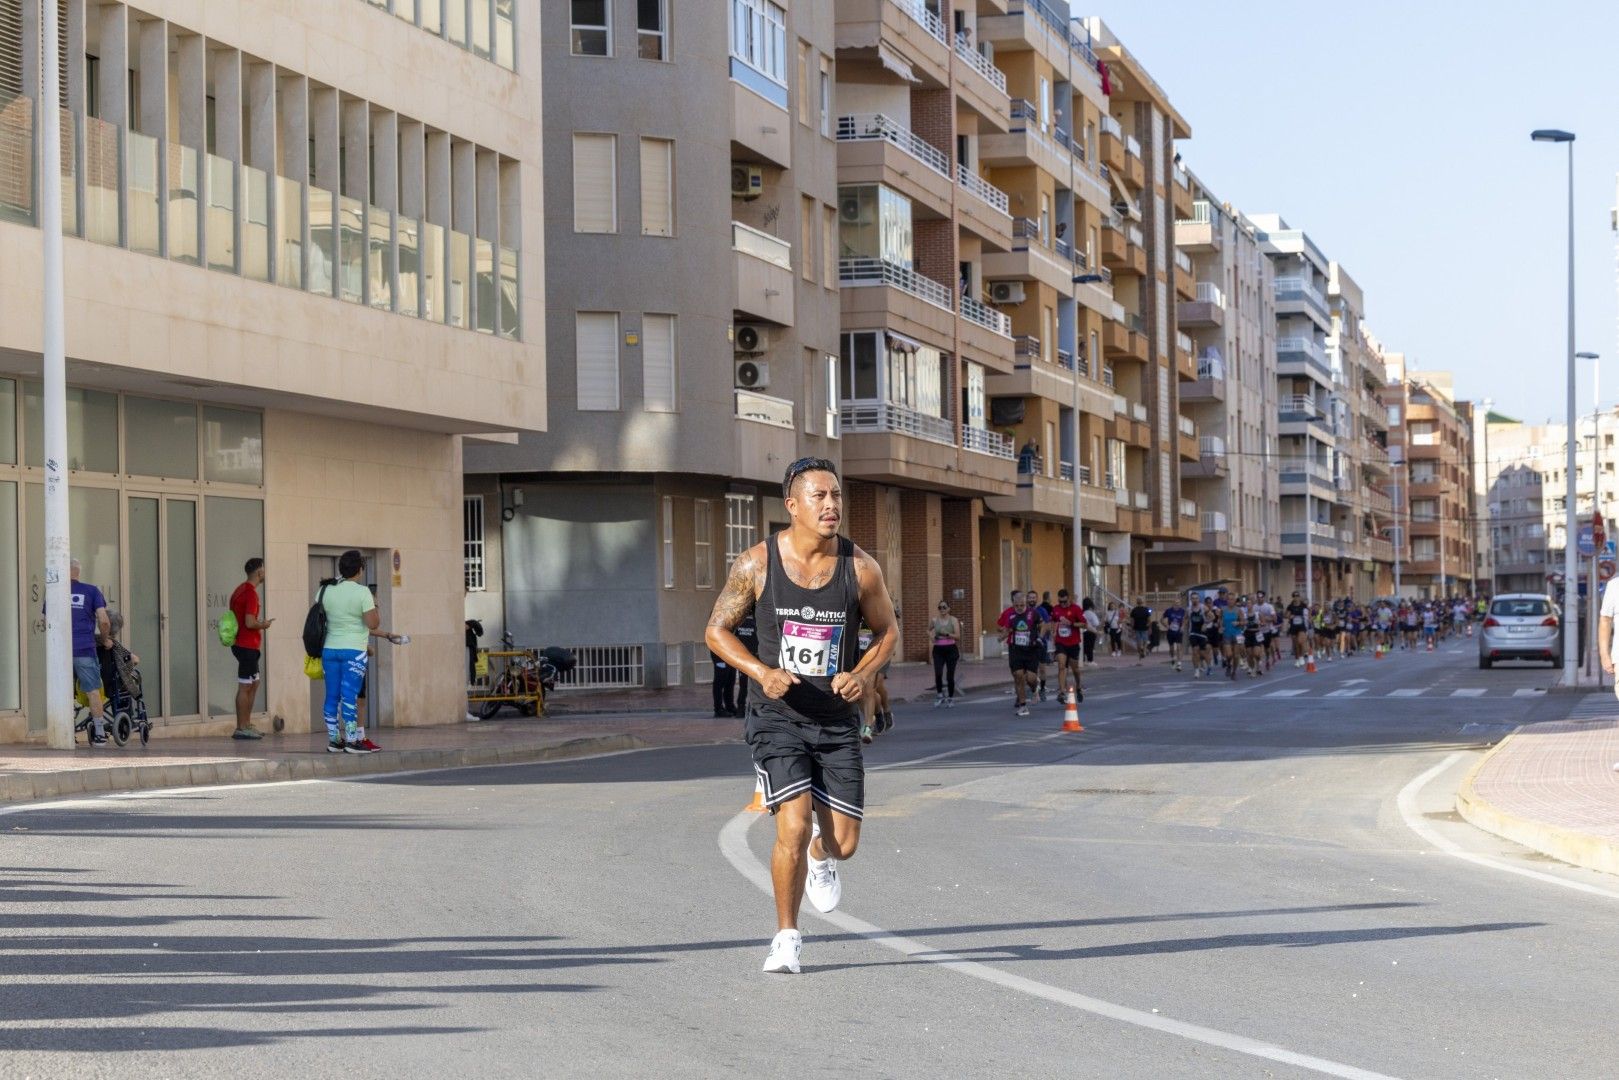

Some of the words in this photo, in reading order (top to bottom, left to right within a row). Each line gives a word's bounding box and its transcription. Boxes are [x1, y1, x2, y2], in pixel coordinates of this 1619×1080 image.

[775, 608, 800, 616] TERRA
[785, 646, 824, 665] 161
[832, 644, 838, 657] KM
